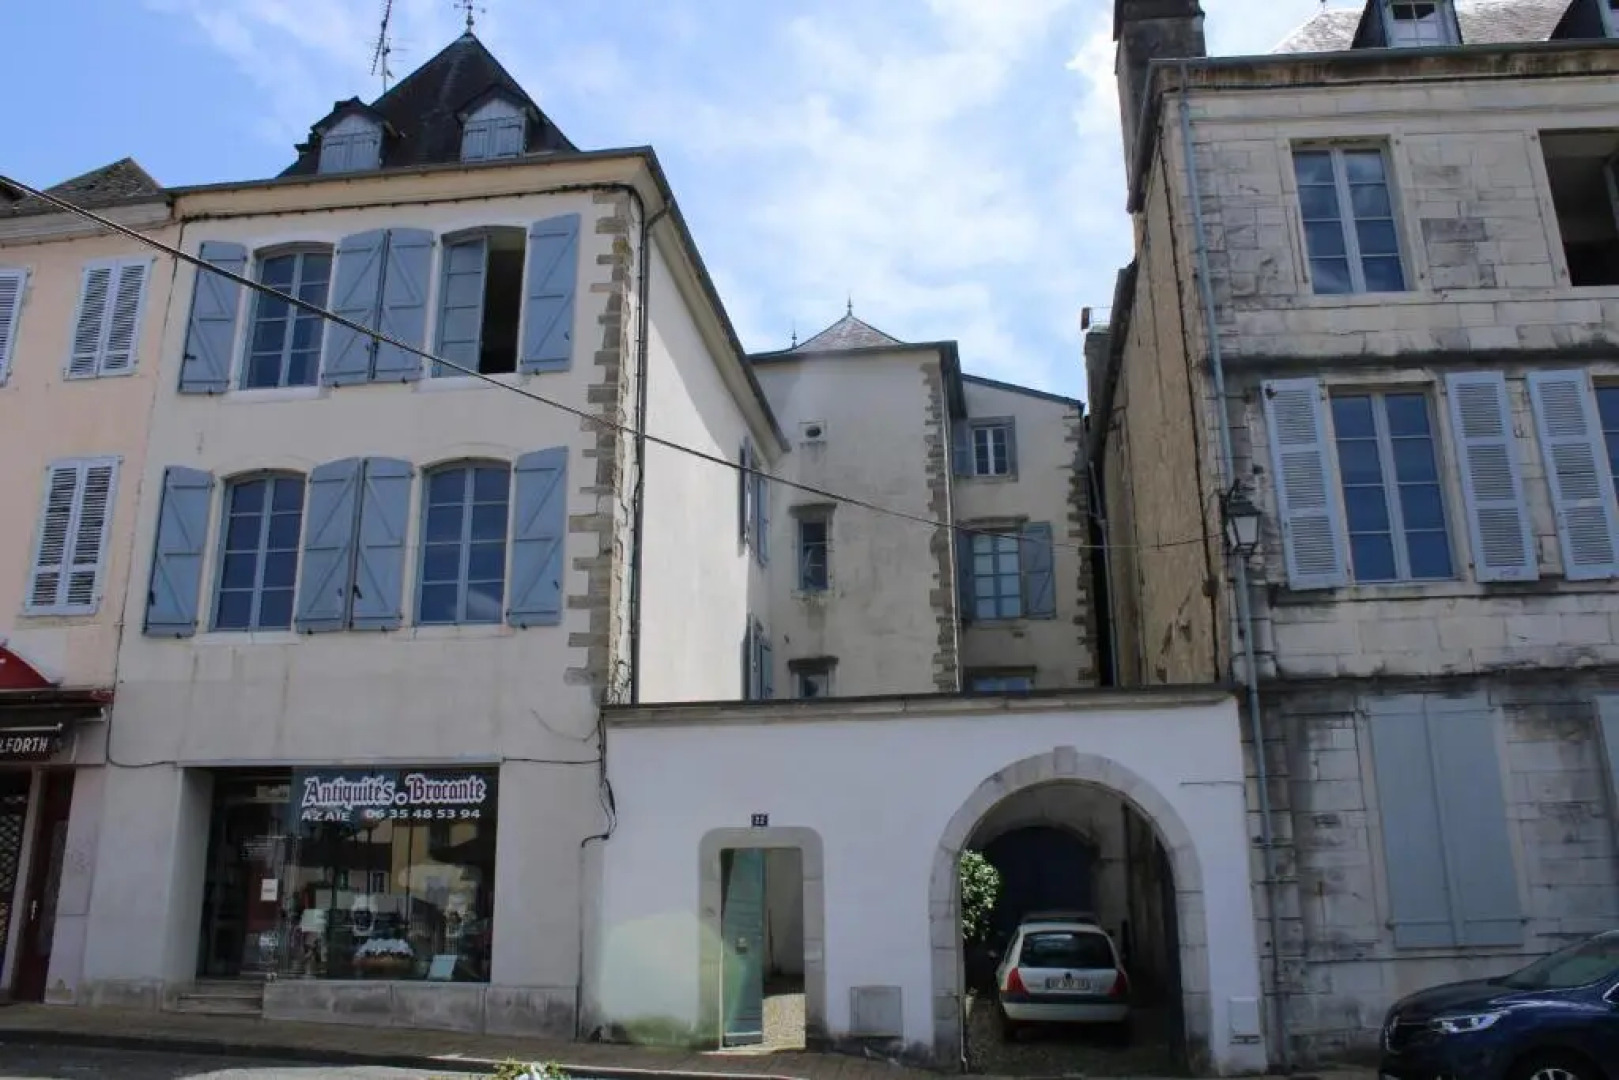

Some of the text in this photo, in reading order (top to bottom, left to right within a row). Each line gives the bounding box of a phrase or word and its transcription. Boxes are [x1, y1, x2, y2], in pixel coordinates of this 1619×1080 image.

[302, 773, 487, 810] Antiquités Brocante
[366, 809, 385, 818] 06
[389, 809, 408, 818] 35
[413, 809, 433, 818] 48
[436, 809, 456, 818] 53
[460, 809, 481, 818] 94
